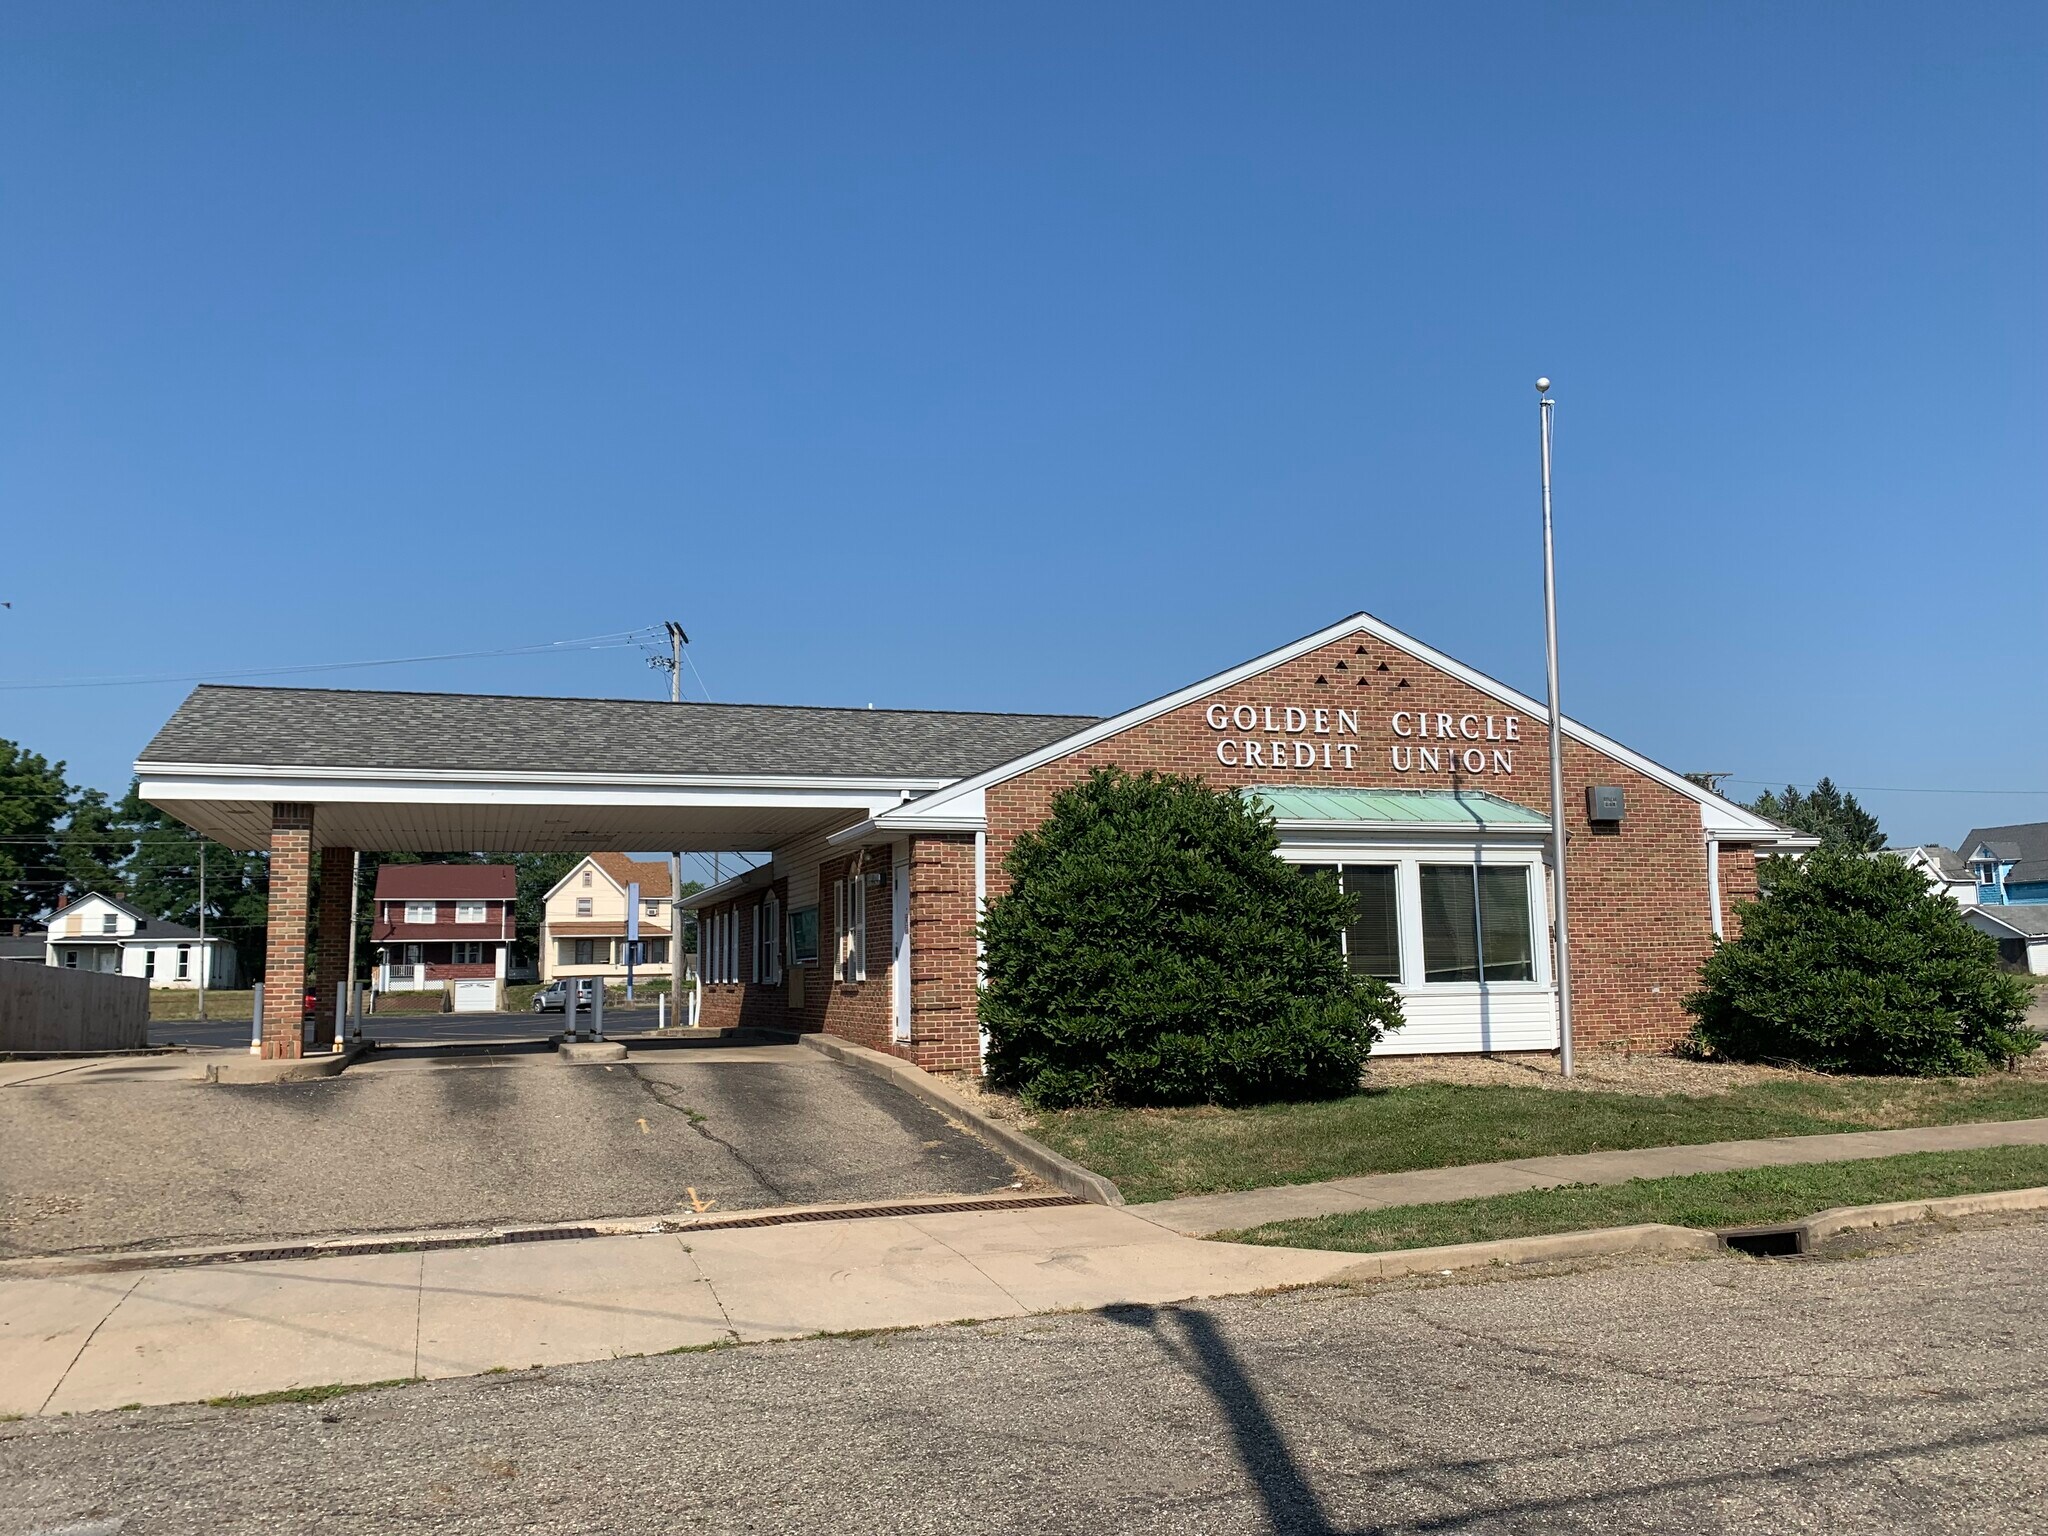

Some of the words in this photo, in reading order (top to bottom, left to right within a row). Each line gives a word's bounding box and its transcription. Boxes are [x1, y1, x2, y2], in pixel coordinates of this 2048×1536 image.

[1206, 703, 1359, 735] GOLDEN
[1391, 711, 1520, 741] CIRCLE
[1216, 739, 1359, 770] CREDIT
[1391, 746, 1513, 775] UNION
